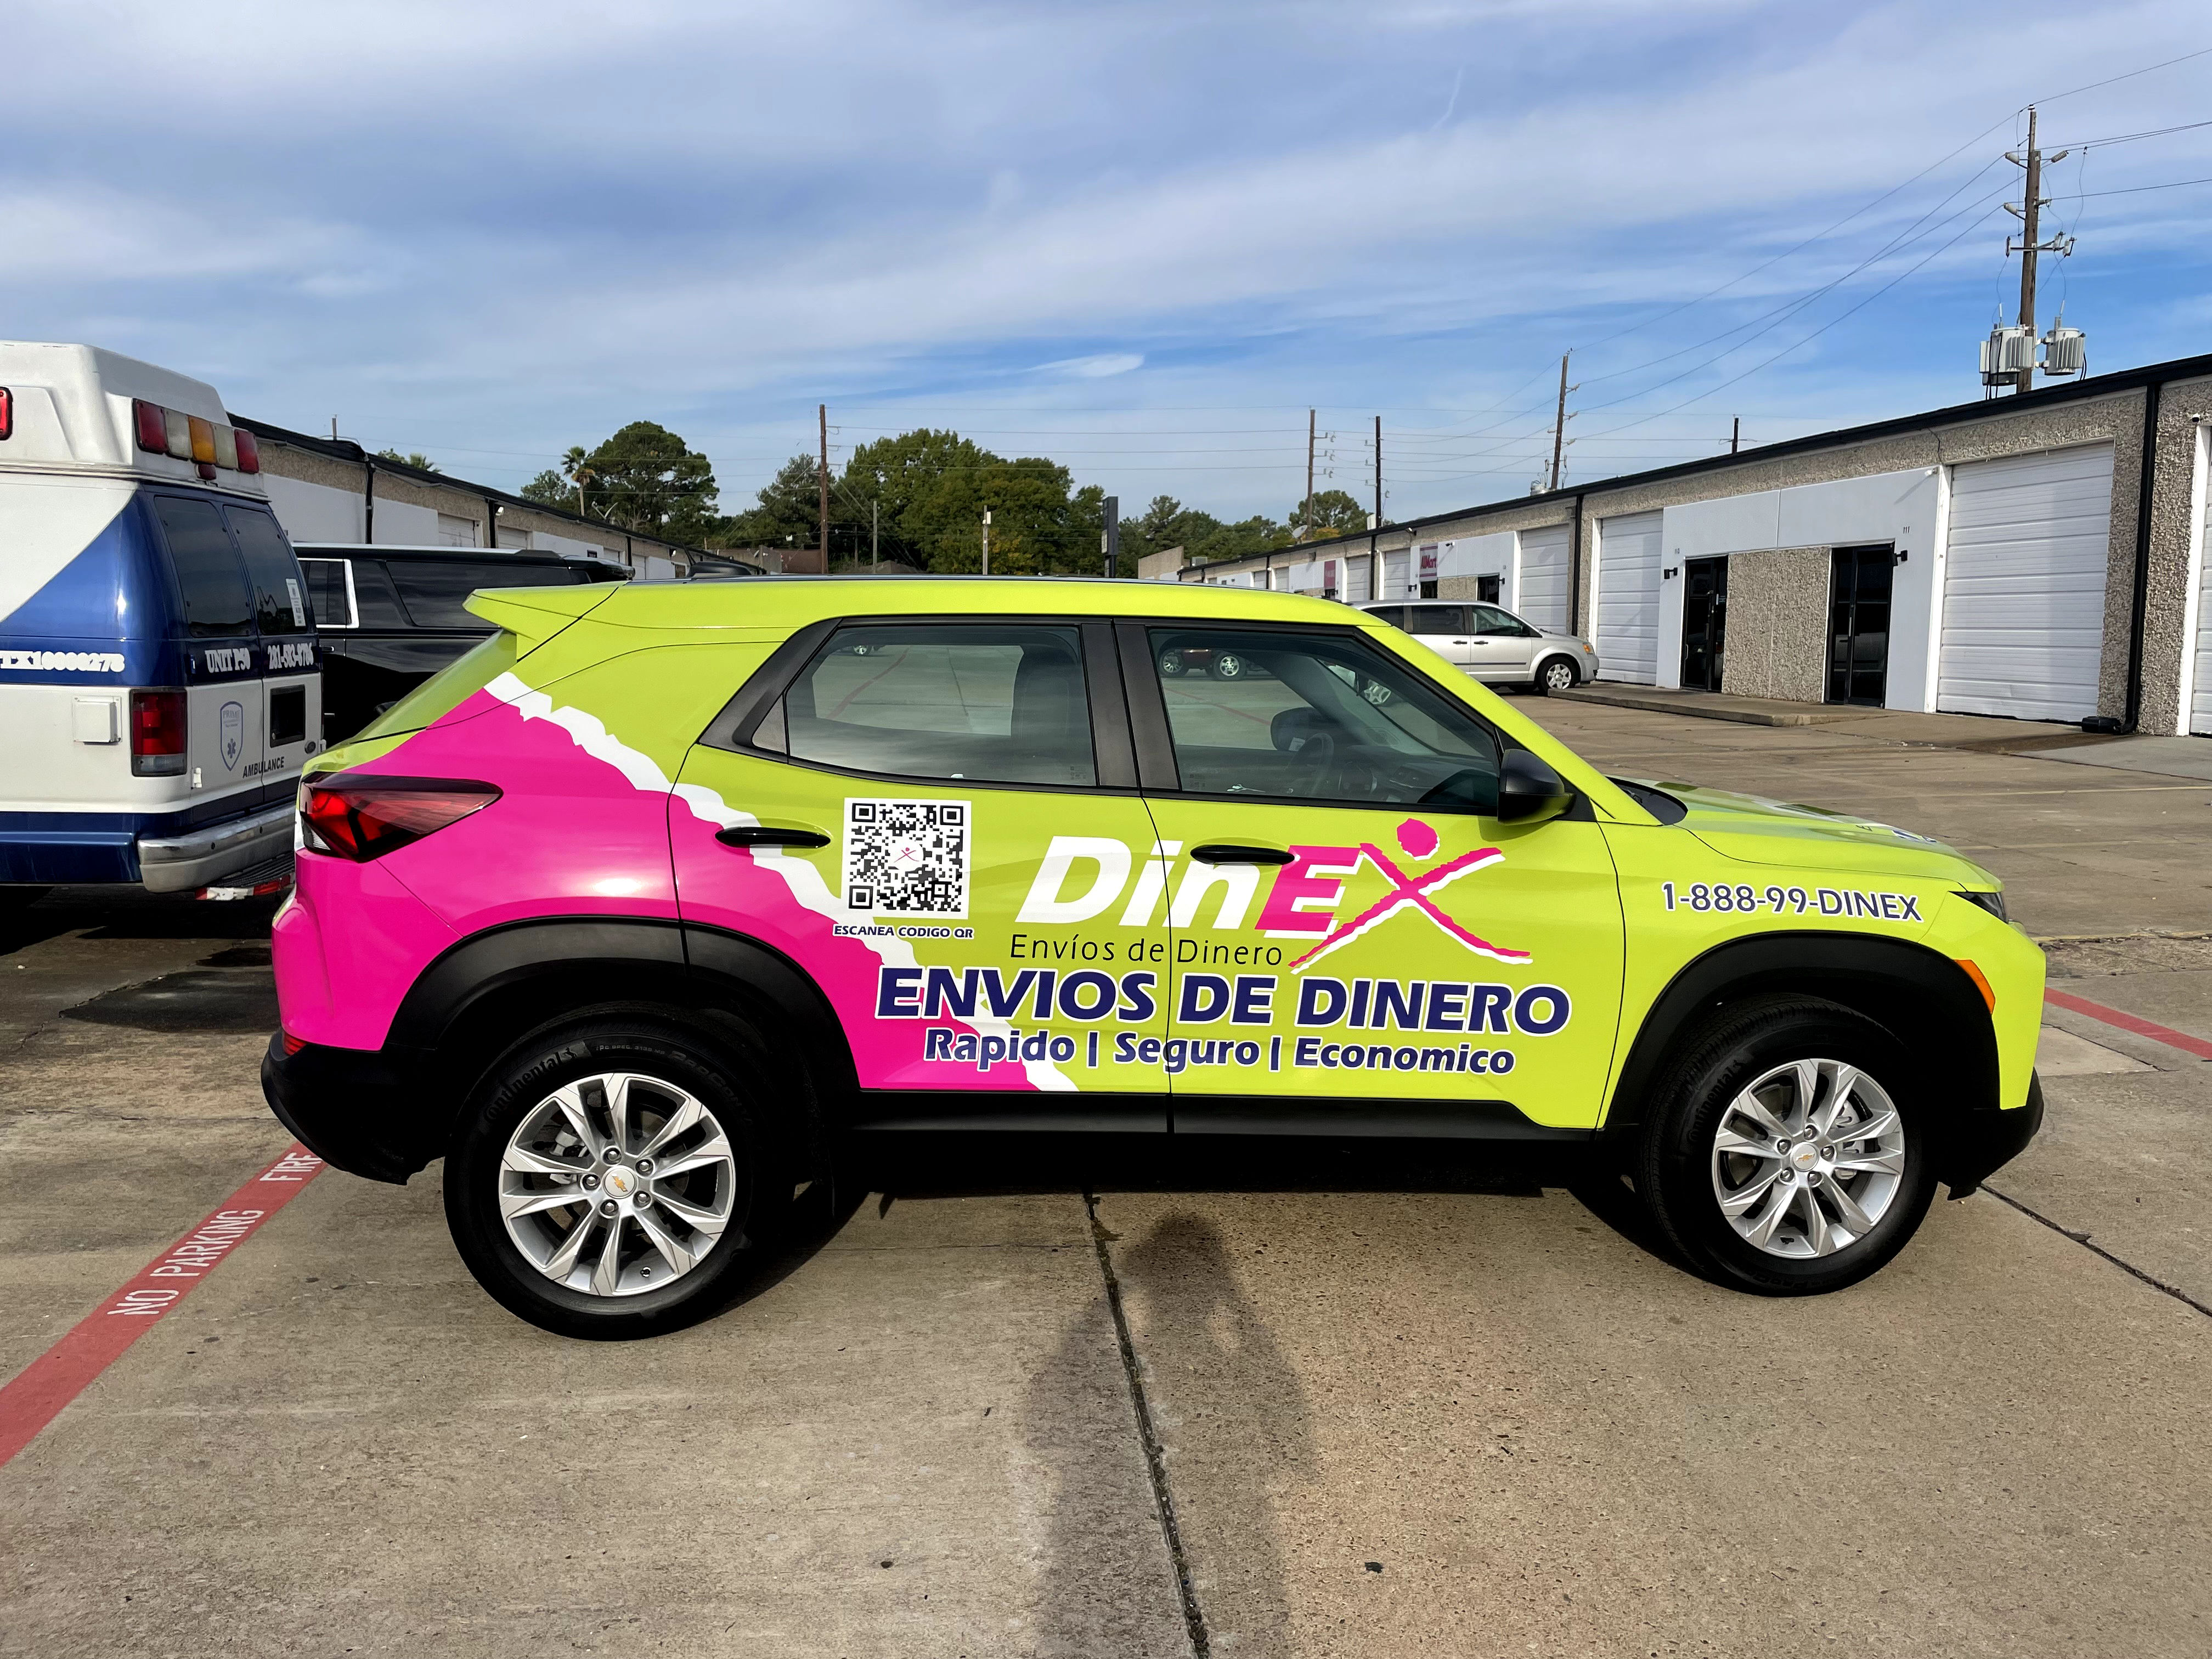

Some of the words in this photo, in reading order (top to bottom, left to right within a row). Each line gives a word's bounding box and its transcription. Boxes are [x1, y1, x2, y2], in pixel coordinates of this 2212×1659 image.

[205, 648, 232, 673] UNIT
[242, 757, 285, 778] AMBULANCE
[1662, 881, 1924, 923] 1-888-99-DINEX
[833, 924, 895, 937] ESCANEA
[898, 925, 951, 939] CODIGO
[953, 927, 975, 940] QR
[1011, 933, 1115, 961] Envíos
[1128, 938, 1164, 962] de
[1177, 939, 1283, 966] Dinero
[875, 964, 1157, 1024] ENVIOS
[1176, 972, 1278, 1026] DE
[1294, 975, 1572, 1037] DINERO
[924, 1027, 1076, 1071] Rapido
[1113, 1031, 1261, 1075] Seguro
[1293, 1036, 1517, 1076] Economico
[108, 1289, 179, 1315] NO
[150, 1210, 265, 1277] PARKING
